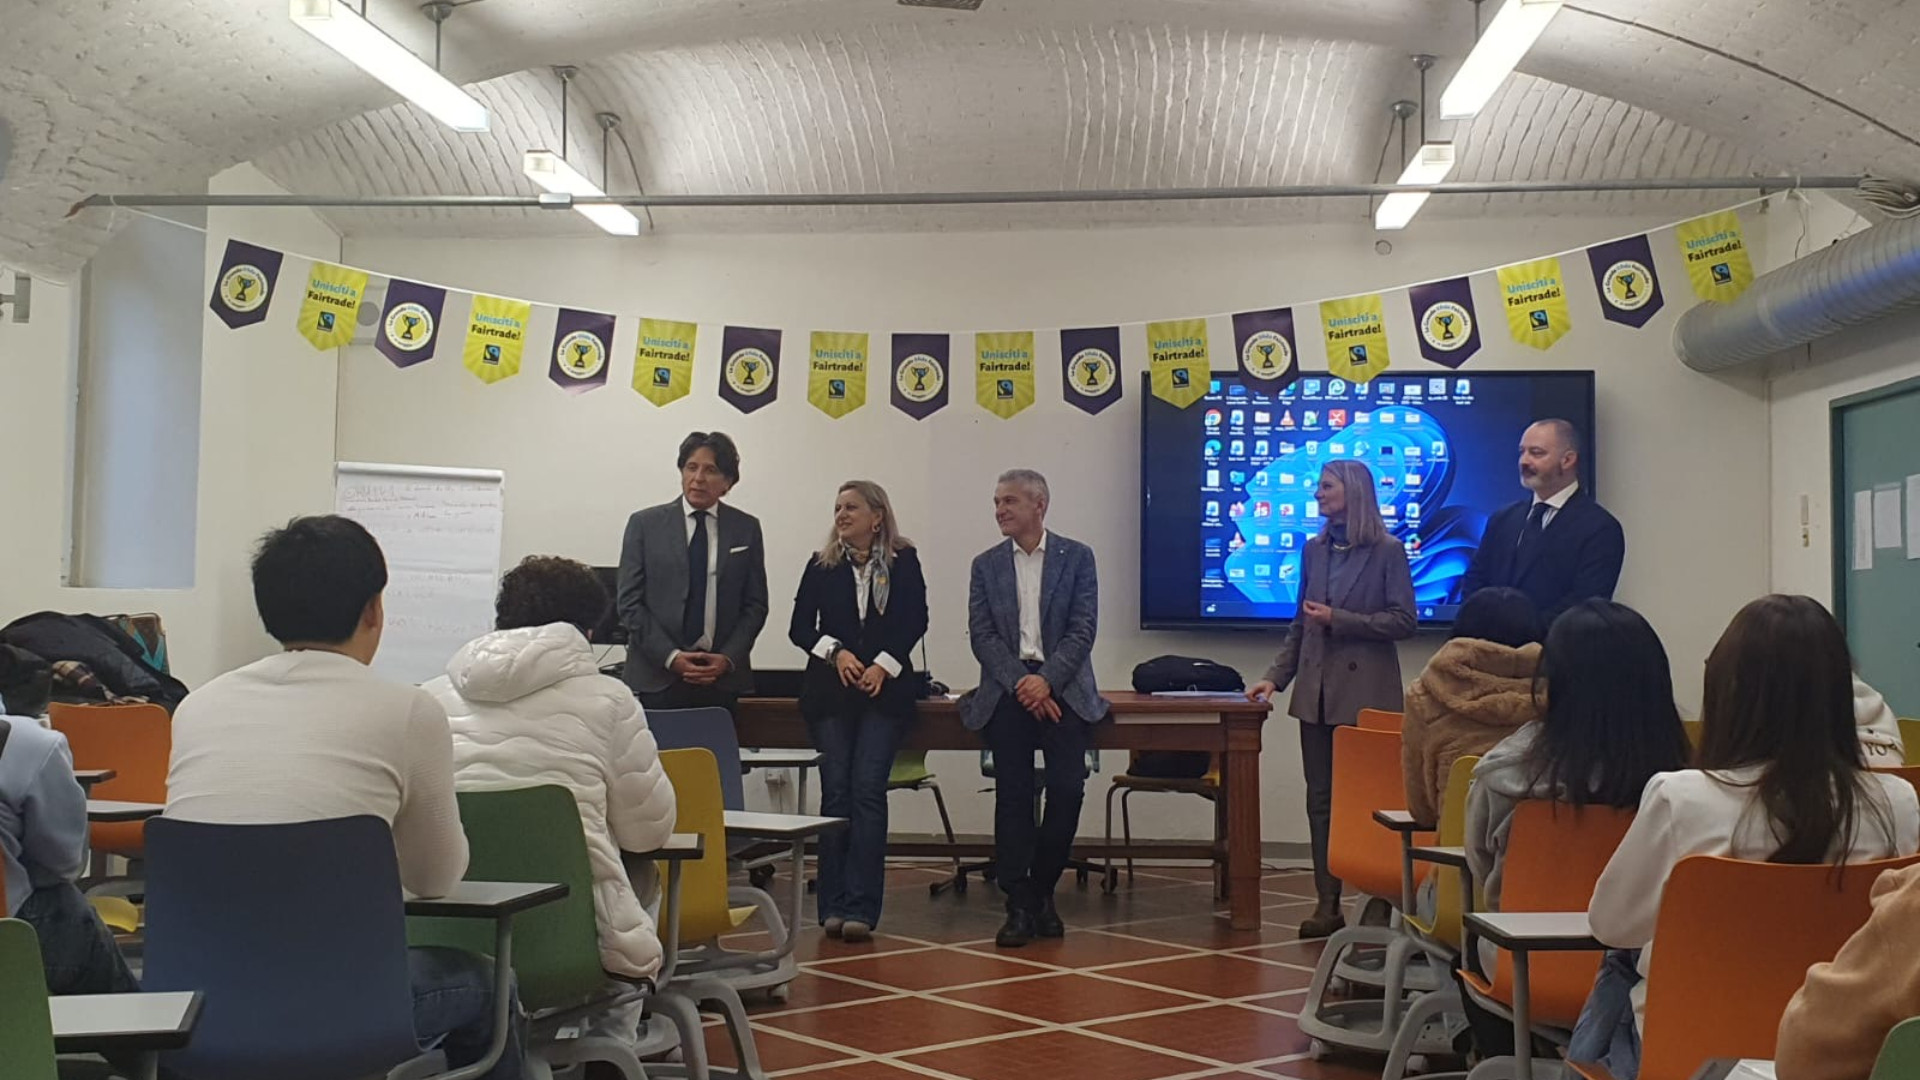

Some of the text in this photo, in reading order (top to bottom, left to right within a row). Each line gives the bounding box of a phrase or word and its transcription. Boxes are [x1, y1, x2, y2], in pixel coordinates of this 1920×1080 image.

[1686, 231, 1728, 248] Unisciti
[1688, 240, 1742, 262] Fairtrade!
[312, 279, 348, 295] Unisciti
[1508, 278, 1548, 293] Unisciti
[307, 290, 356, 309] Fairtrade!
[1508, 287, 1560, 306] Fairtrade!
[476, 312, 512, 326] Unisciti
[1329, 313, 1369, 327] Unisciti
[471, 324, 521, 340] Fairtrade!
[1328, 324, 1382, 340] Fairtrade!
[643, 336, 681, 348] Unisciti
[1154, 338, 1193, 349] Unisciti
[640, 348, 690, 361] Fairtrade!
[816, 349, 853, 359] Unisciti
[981, 350, 1021, 359] Unisciti
[1153, 349, 1205, 362] Fairtrade!
[813, 361, 864, 372] Fairtrade!
[980, 362, 1030, 371] Fairtrade!
